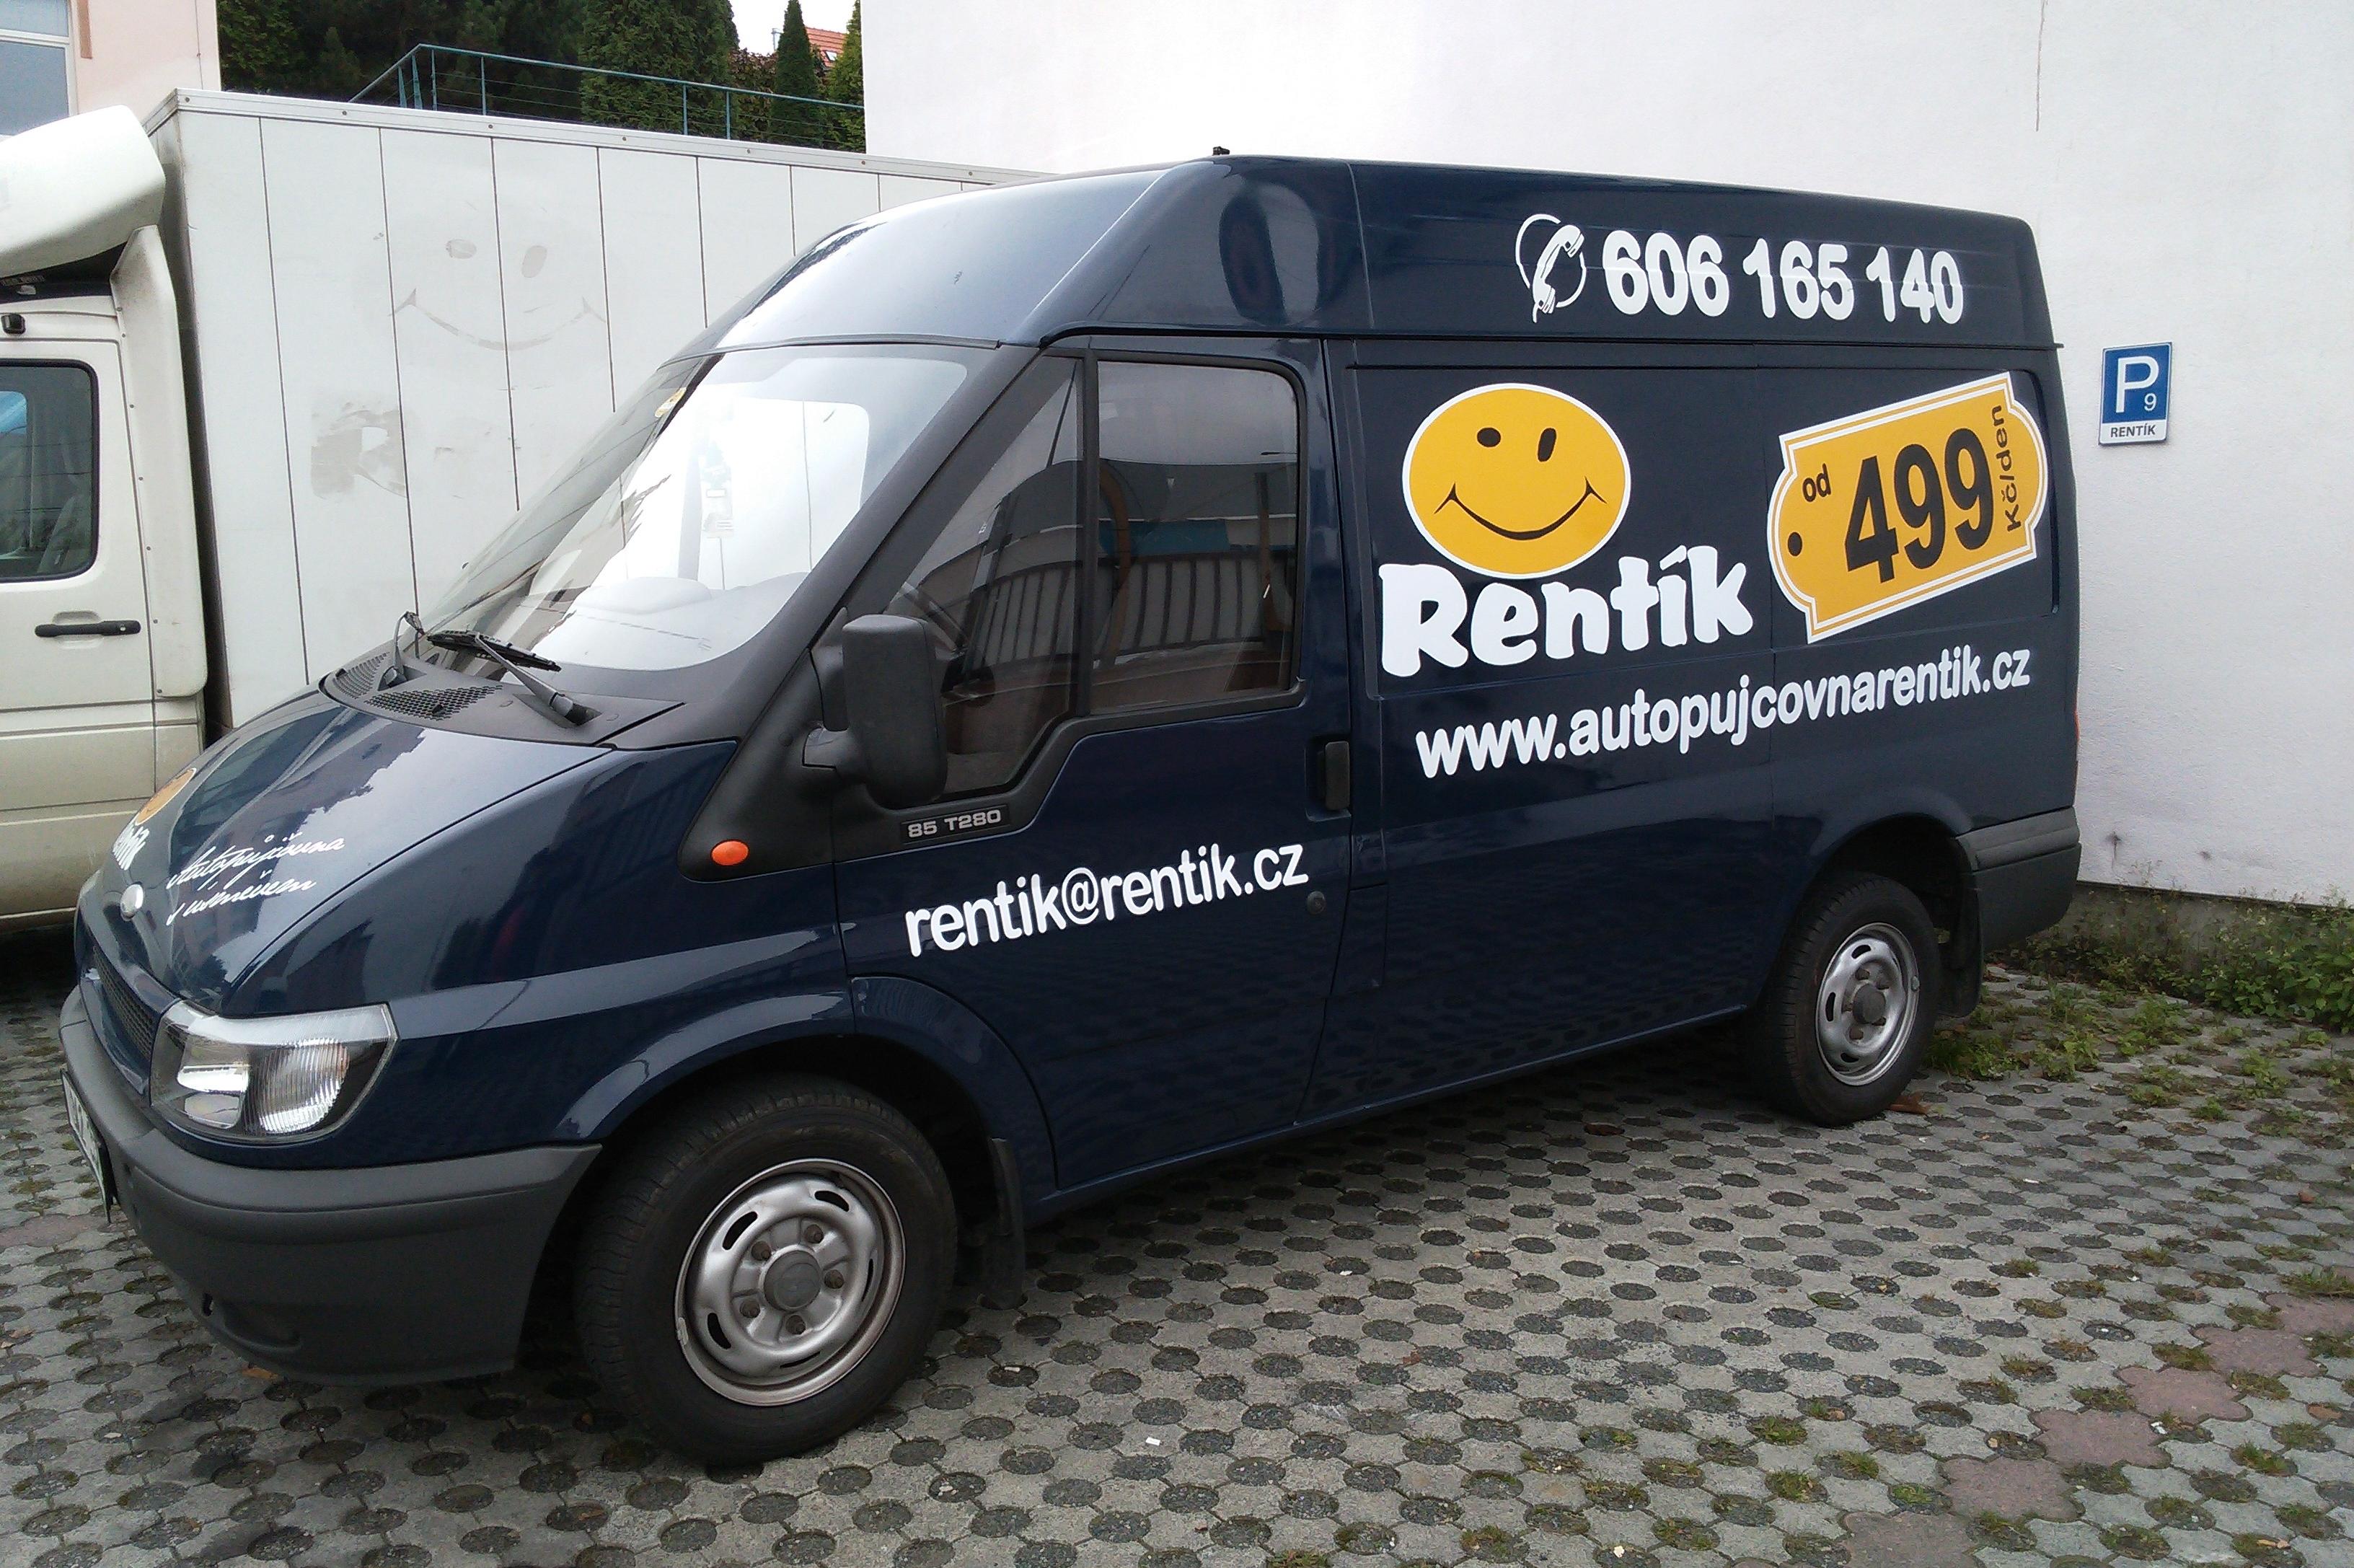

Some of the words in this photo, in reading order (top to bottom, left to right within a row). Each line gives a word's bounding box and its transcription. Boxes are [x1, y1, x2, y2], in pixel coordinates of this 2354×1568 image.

[1603, 231, 1729, 317] 606
[1742, 238, 1854, 320] 165
[1866, 247, 1964, 324] 140
[2110, 423, 2156, 438] RENTÍK
[2115, 356, 2159, 413] P
[2143, 392, 2157, 412] 9
[1802, 462, 1832, 502] od
[1844, 428, 1994, 584] 499
[1991, 405, 2022, 532] Kč/den
[1378, 545, 1753, 677] Rentík
[1415, 645, 2031, 778] www.autopujcovnarentik.cz
[907, 820, 938, 838] 85
[943, 809, 1002, 831] T280
[904, 843, 1309, 957] rentik@rentik.cz
